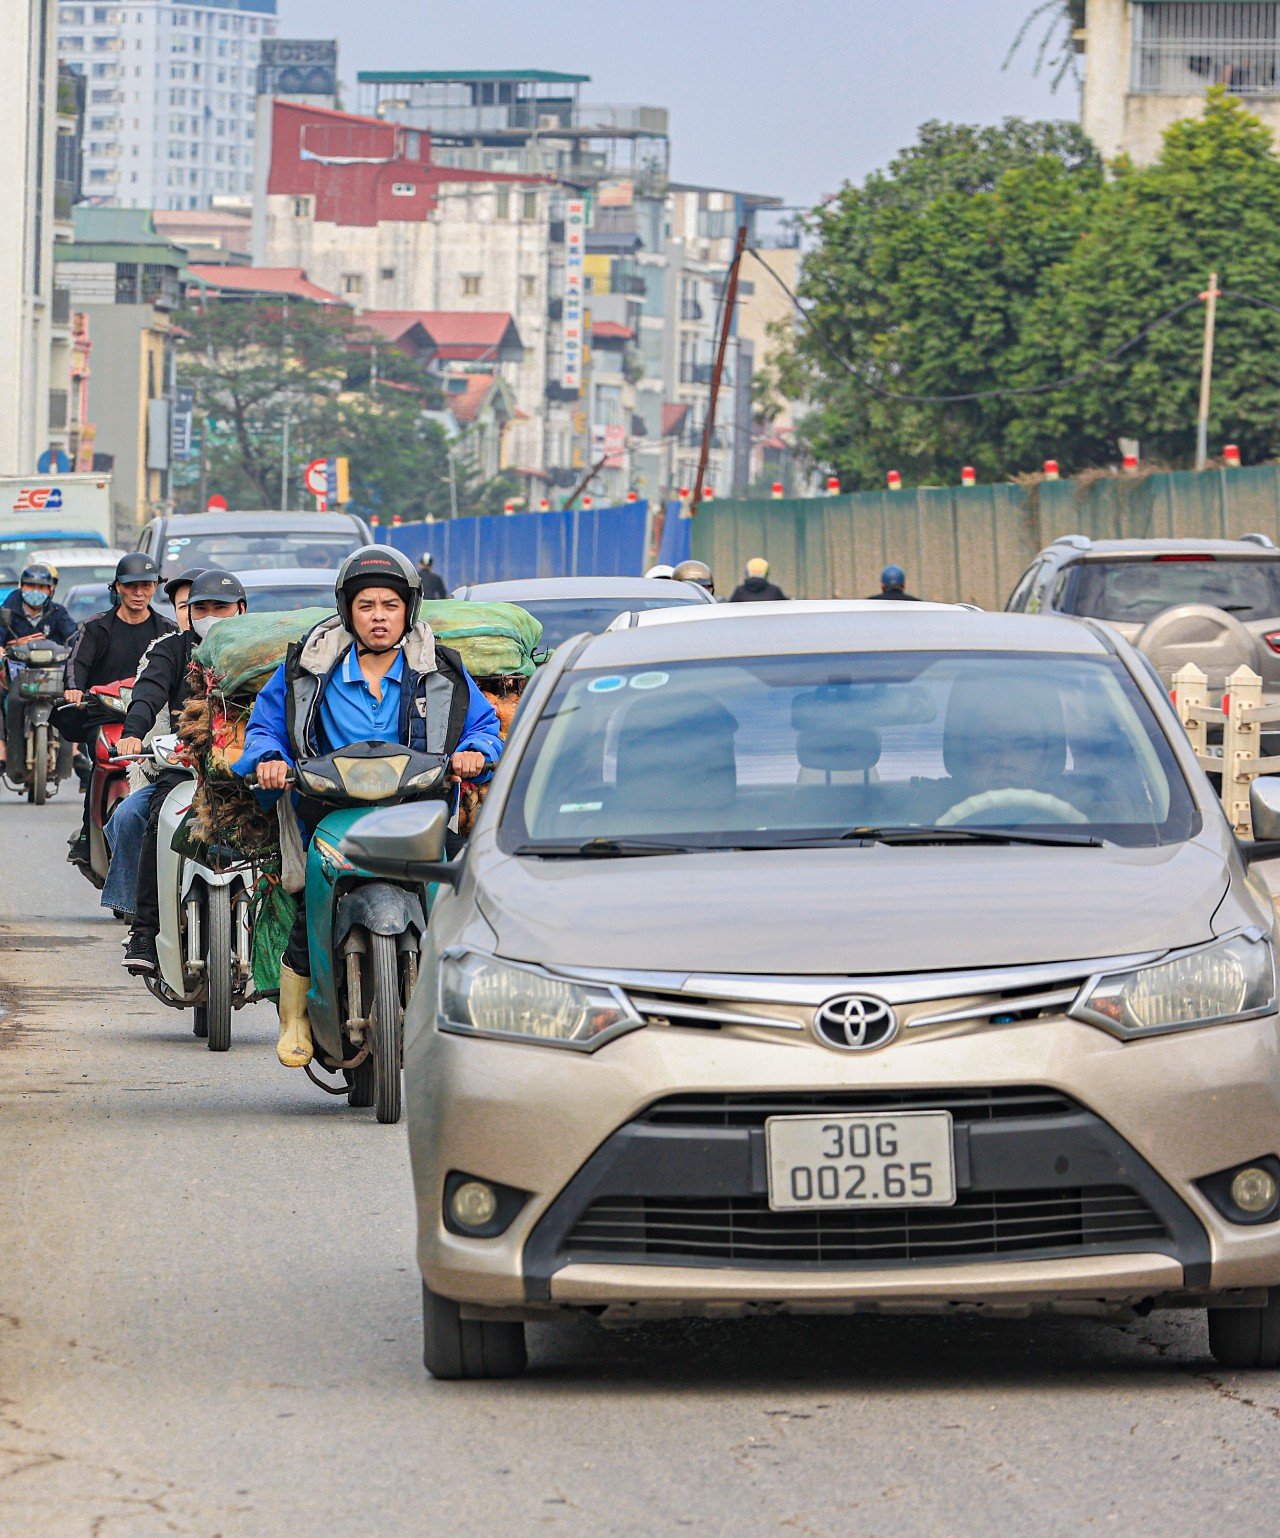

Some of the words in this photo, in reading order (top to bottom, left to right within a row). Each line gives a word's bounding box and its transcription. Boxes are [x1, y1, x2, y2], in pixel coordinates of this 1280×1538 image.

[564, 329, 578, 384] HOTEL
[822, 1122, 898, 1159] 30G
[791, 1162, 933, 1201] 002.65
